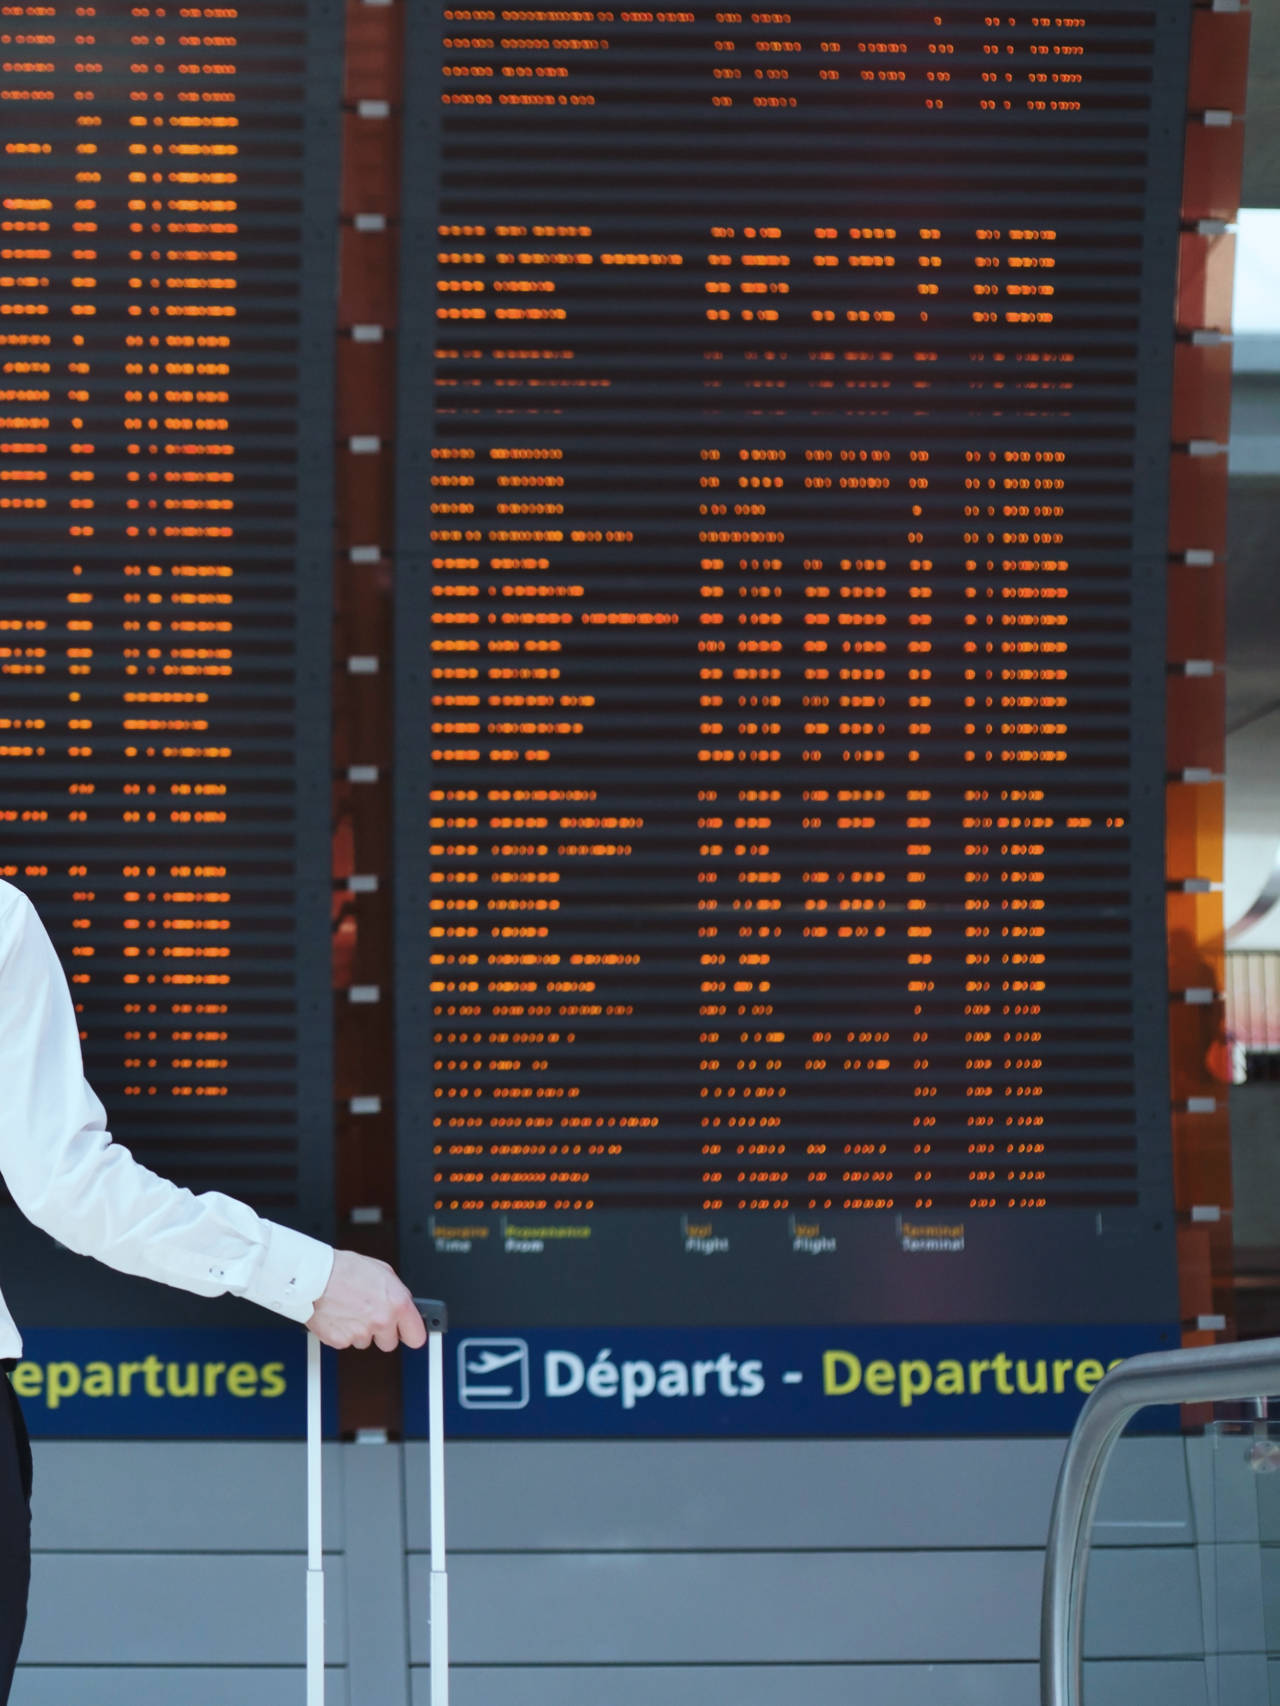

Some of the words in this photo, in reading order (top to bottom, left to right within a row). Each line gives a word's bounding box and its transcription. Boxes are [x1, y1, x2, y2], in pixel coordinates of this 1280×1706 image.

[685, 1237, 729, 1255] Flight
[793, 1237, 837, 1255] Flight
[902, 1237, 964, 1251] Terminal
[9, 1354, 287, 1409] epartures
[544, 1348, 765, 1409] Départs
[822, 1349, 1124, 1408] Departure
